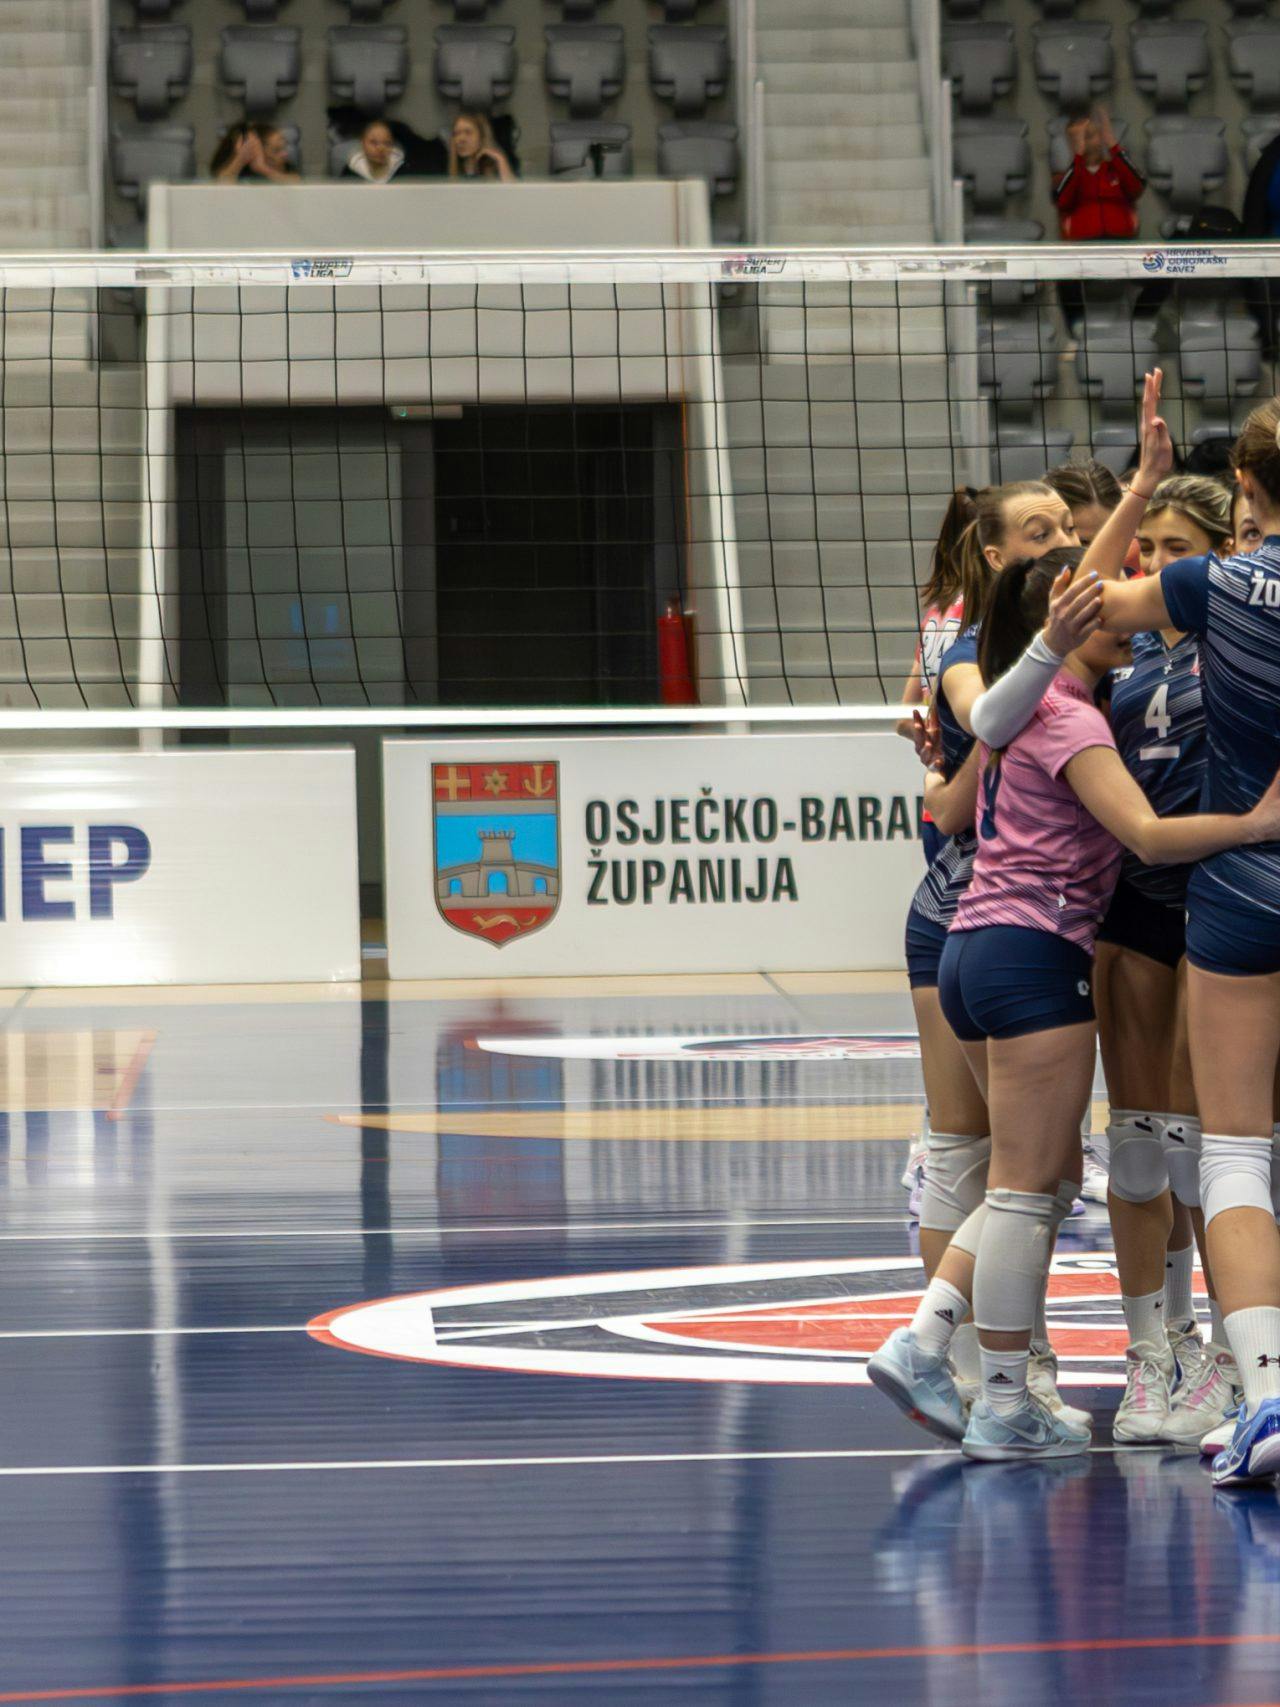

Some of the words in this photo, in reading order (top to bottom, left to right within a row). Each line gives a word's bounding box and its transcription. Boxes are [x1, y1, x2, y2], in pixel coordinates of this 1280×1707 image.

[310, 269, 335, 278] LIGA
[742, 265, 768, 275] LIGA
[1166, 265, 1196, 273] SAVEZ
[1143, 684, 1172, 738] 4
[0, 826, 152, 922] EP
[586, 848, 799, 905] ŽUPANIJA
